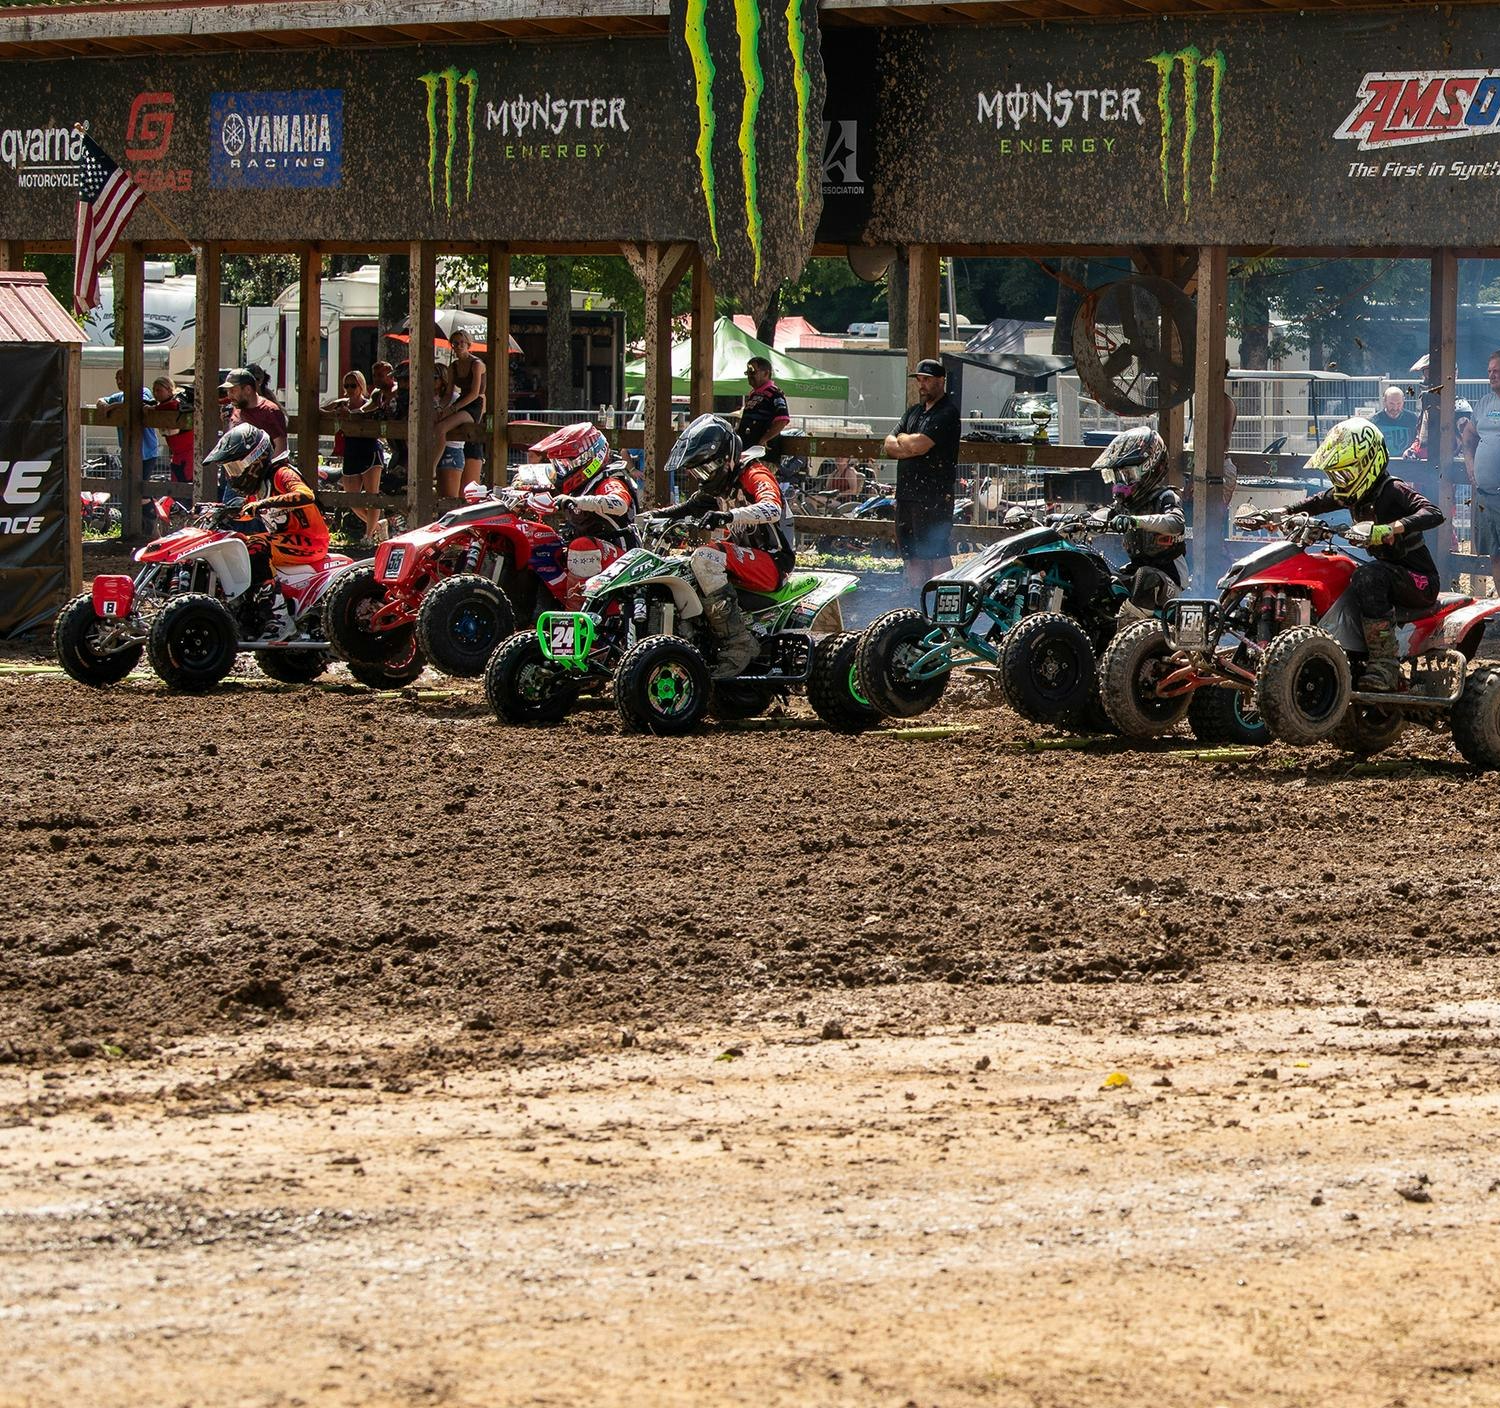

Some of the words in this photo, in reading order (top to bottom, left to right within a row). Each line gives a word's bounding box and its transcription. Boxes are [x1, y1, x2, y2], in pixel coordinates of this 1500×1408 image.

[977, 82, 1146, 130] MONSTER
[486, 93, 630, 137] MONSTER
[247, 113, 331, 152] YAMAHA
[505, 144, 604, 158] ENERGY
[1000, 138, 1116, 153] ENERGY
[230, 157, 325, 168] RACING
[1347, 162, 1377, 177] The
[1382, 161, 1425, 177] First
[1428, 161, 1445, 177] in
[822, 186, 864, 194] SSOCIATION
[106, 602, 115, 614] 8
[552, 626, 575, 648] 24
